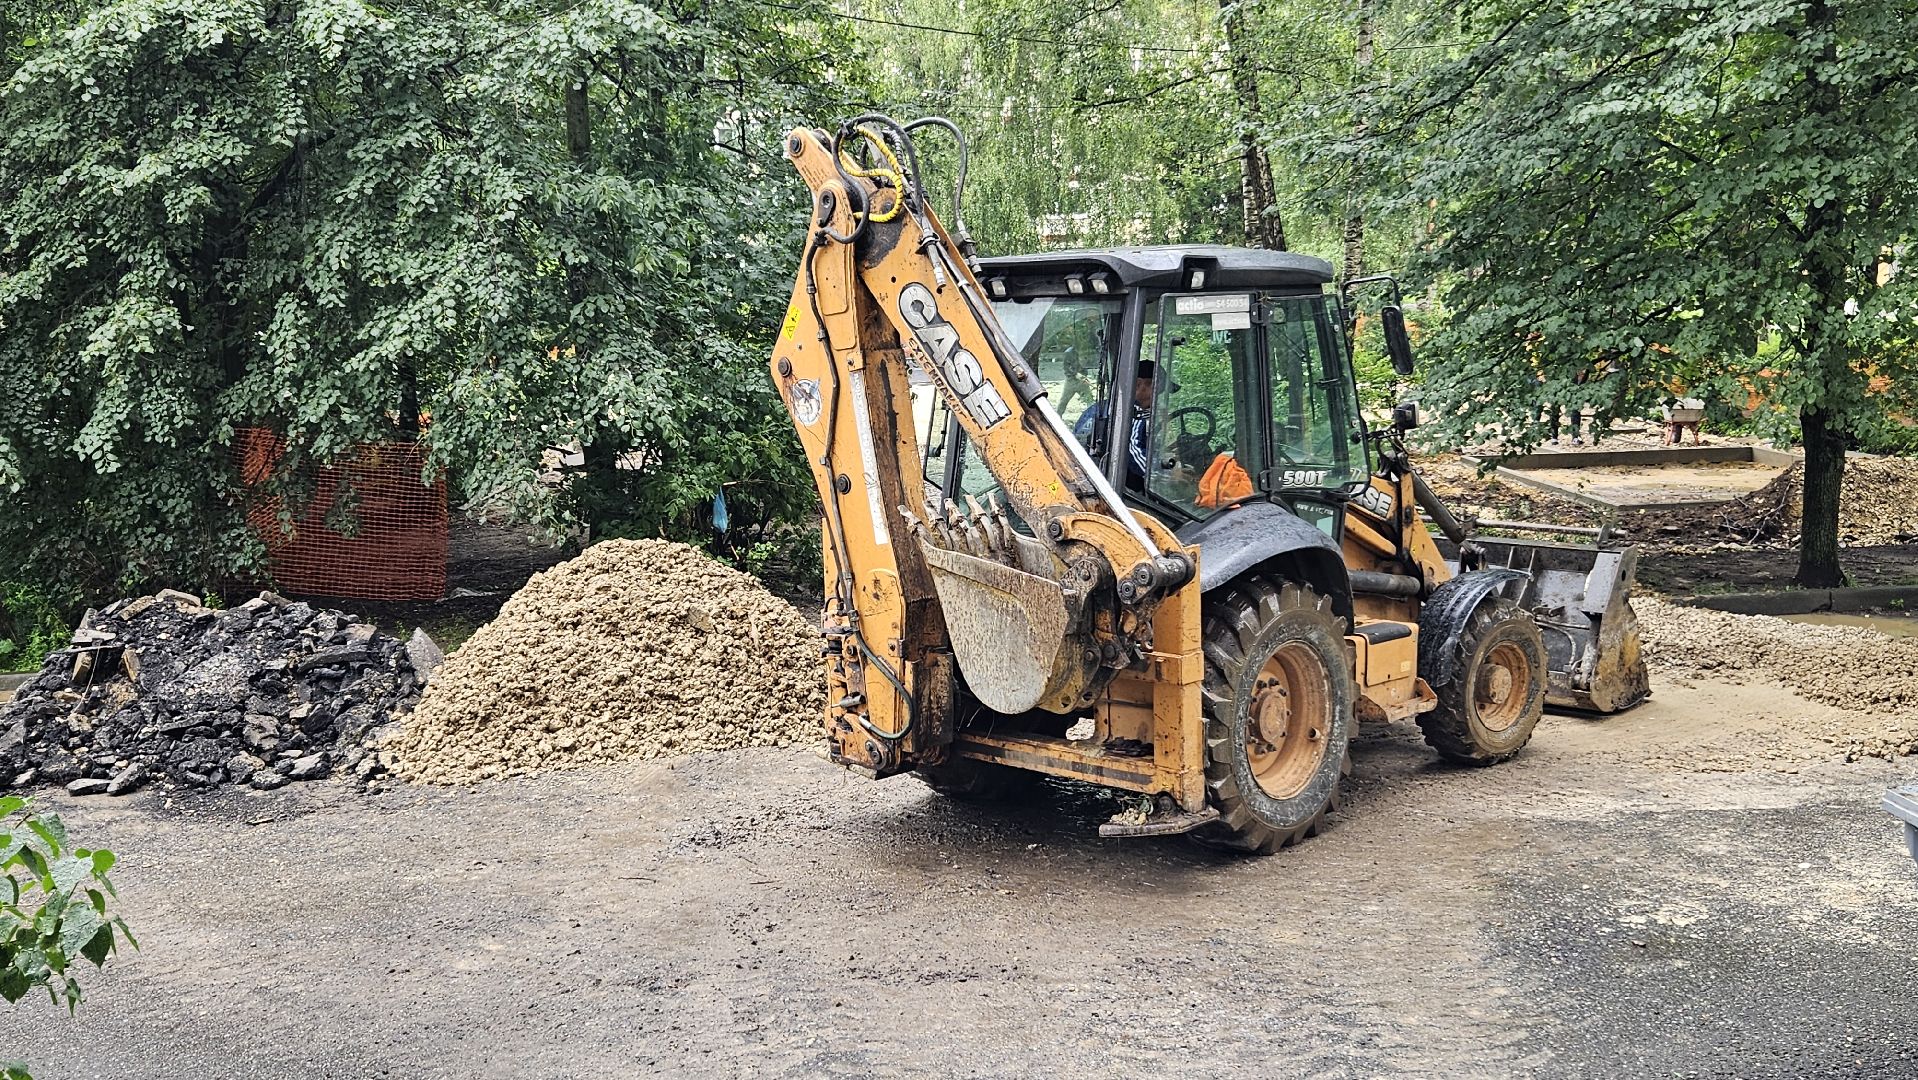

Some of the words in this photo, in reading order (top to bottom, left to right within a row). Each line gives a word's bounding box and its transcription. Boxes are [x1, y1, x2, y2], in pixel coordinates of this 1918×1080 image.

[899, 282, 1012, 430] CASE
[1282, 470, 1328, 487] 580T
[1348, 483, 1392, 518] ASE
